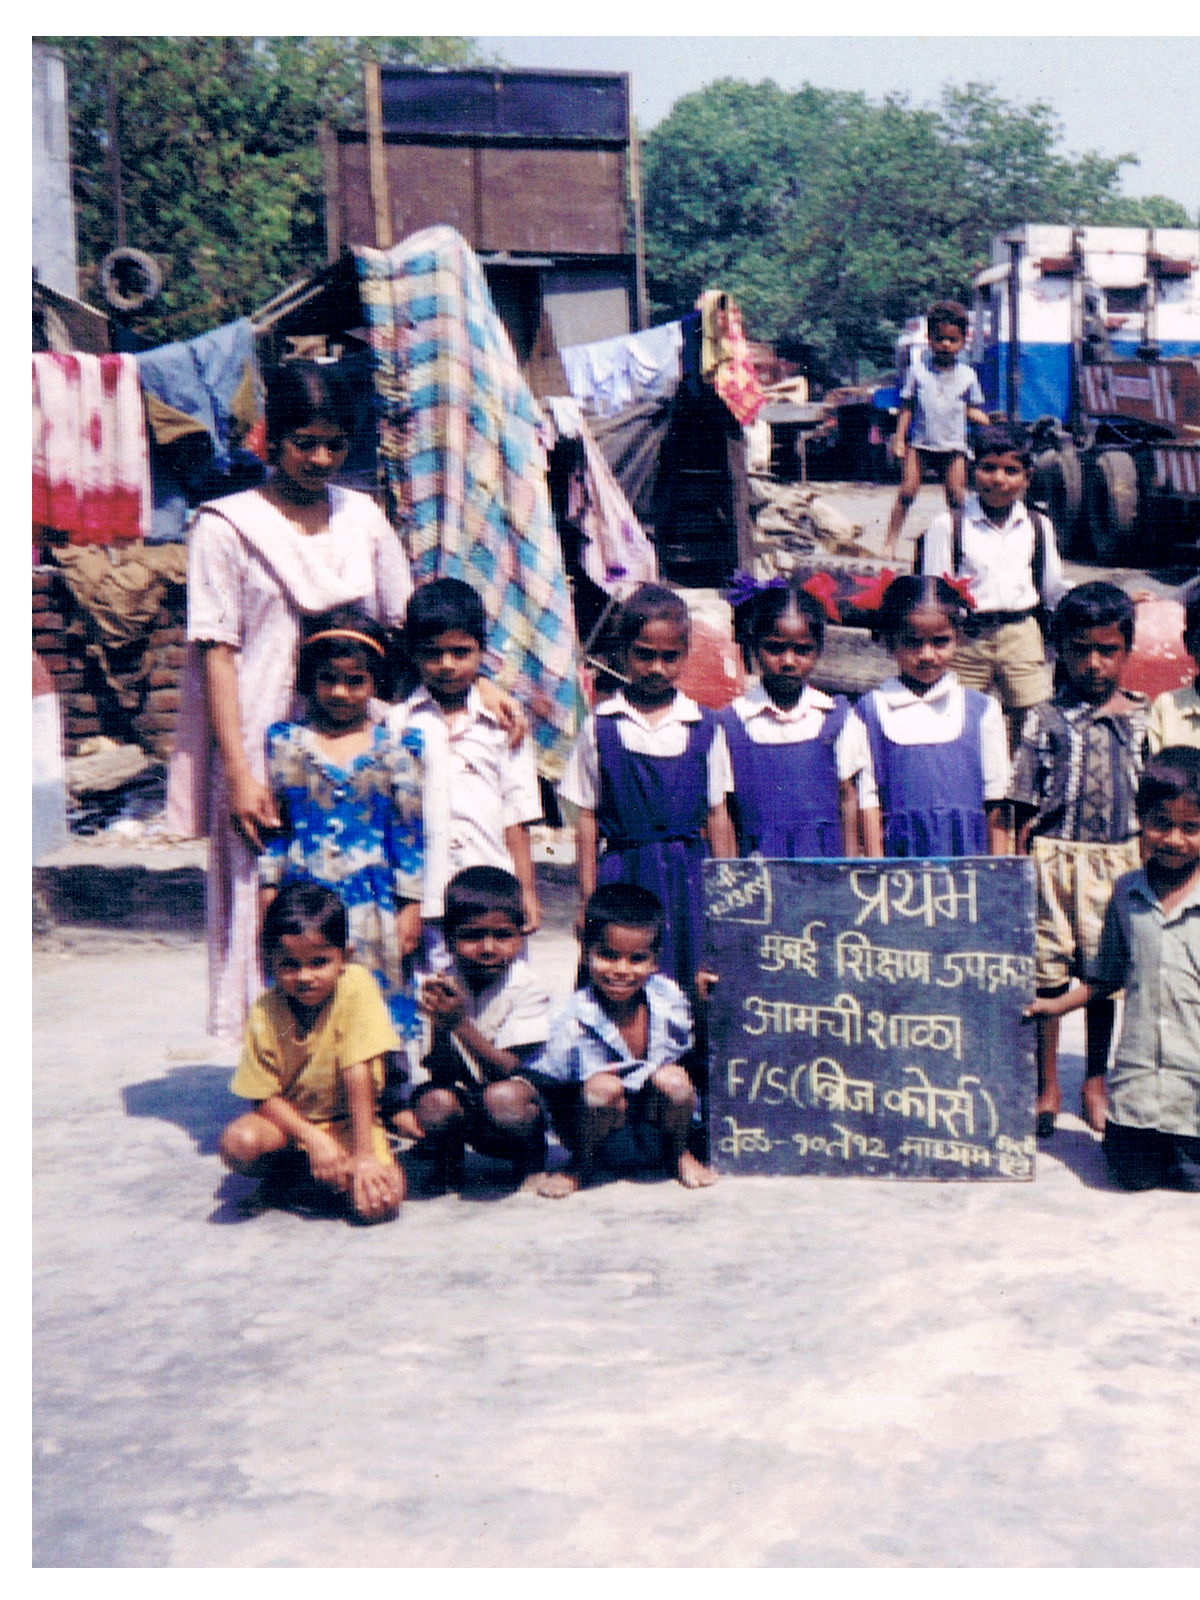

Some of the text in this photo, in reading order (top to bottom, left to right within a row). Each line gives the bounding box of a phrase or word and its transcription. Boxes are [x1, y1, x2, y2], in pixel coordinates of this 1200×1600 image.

[850, 869, 977, 927] प्रथम
[836, 930, 932, 985] शिक्षण
[742, 993, 962, 1061] आमची शाळा
